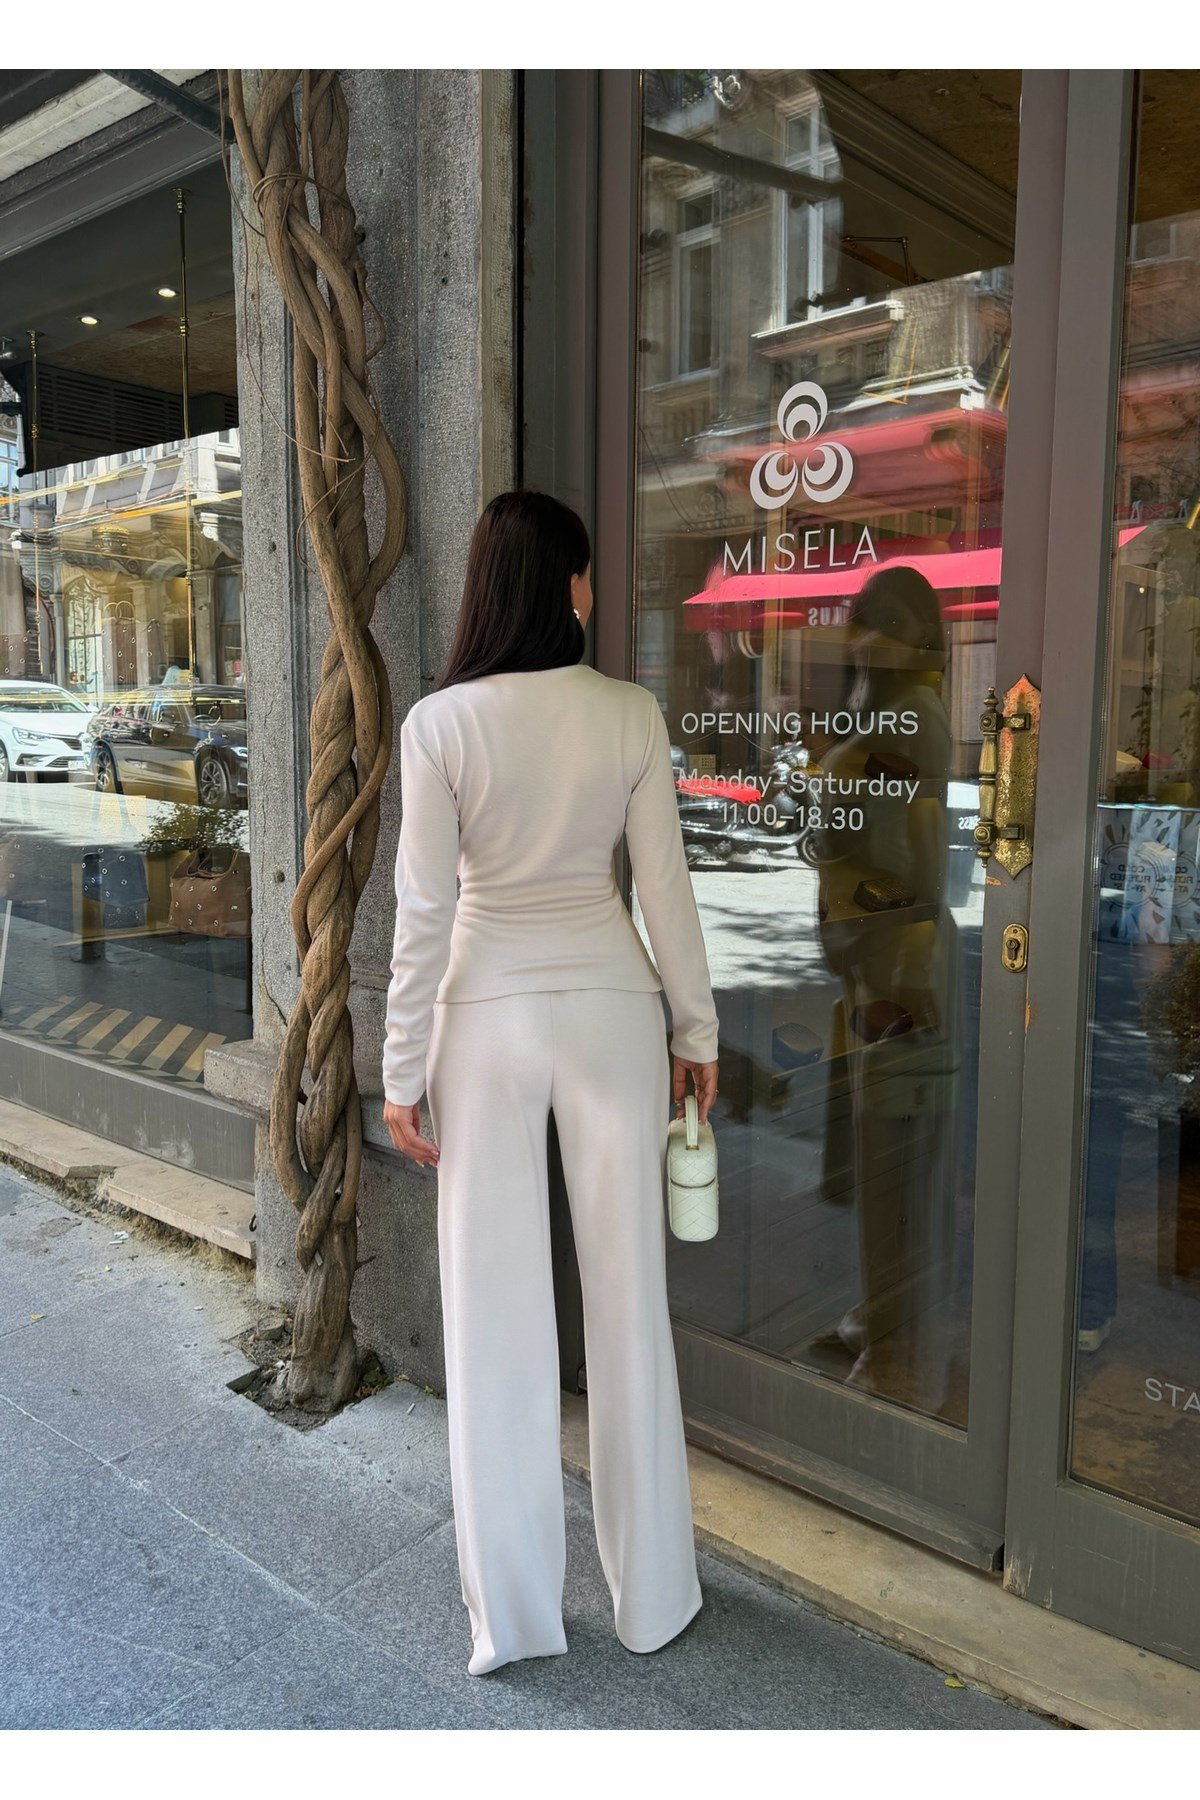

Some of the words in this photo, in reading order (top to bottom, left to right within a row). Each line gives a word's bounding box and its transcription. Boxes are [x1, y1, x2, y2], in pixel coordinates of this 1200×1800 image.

[723, 526, 878, 576] MISELA
[681, 711, 801, 736] OPENING
[811, 711, 919, 735] HOURS
[1145, 1378, 1200, 1413] STA
